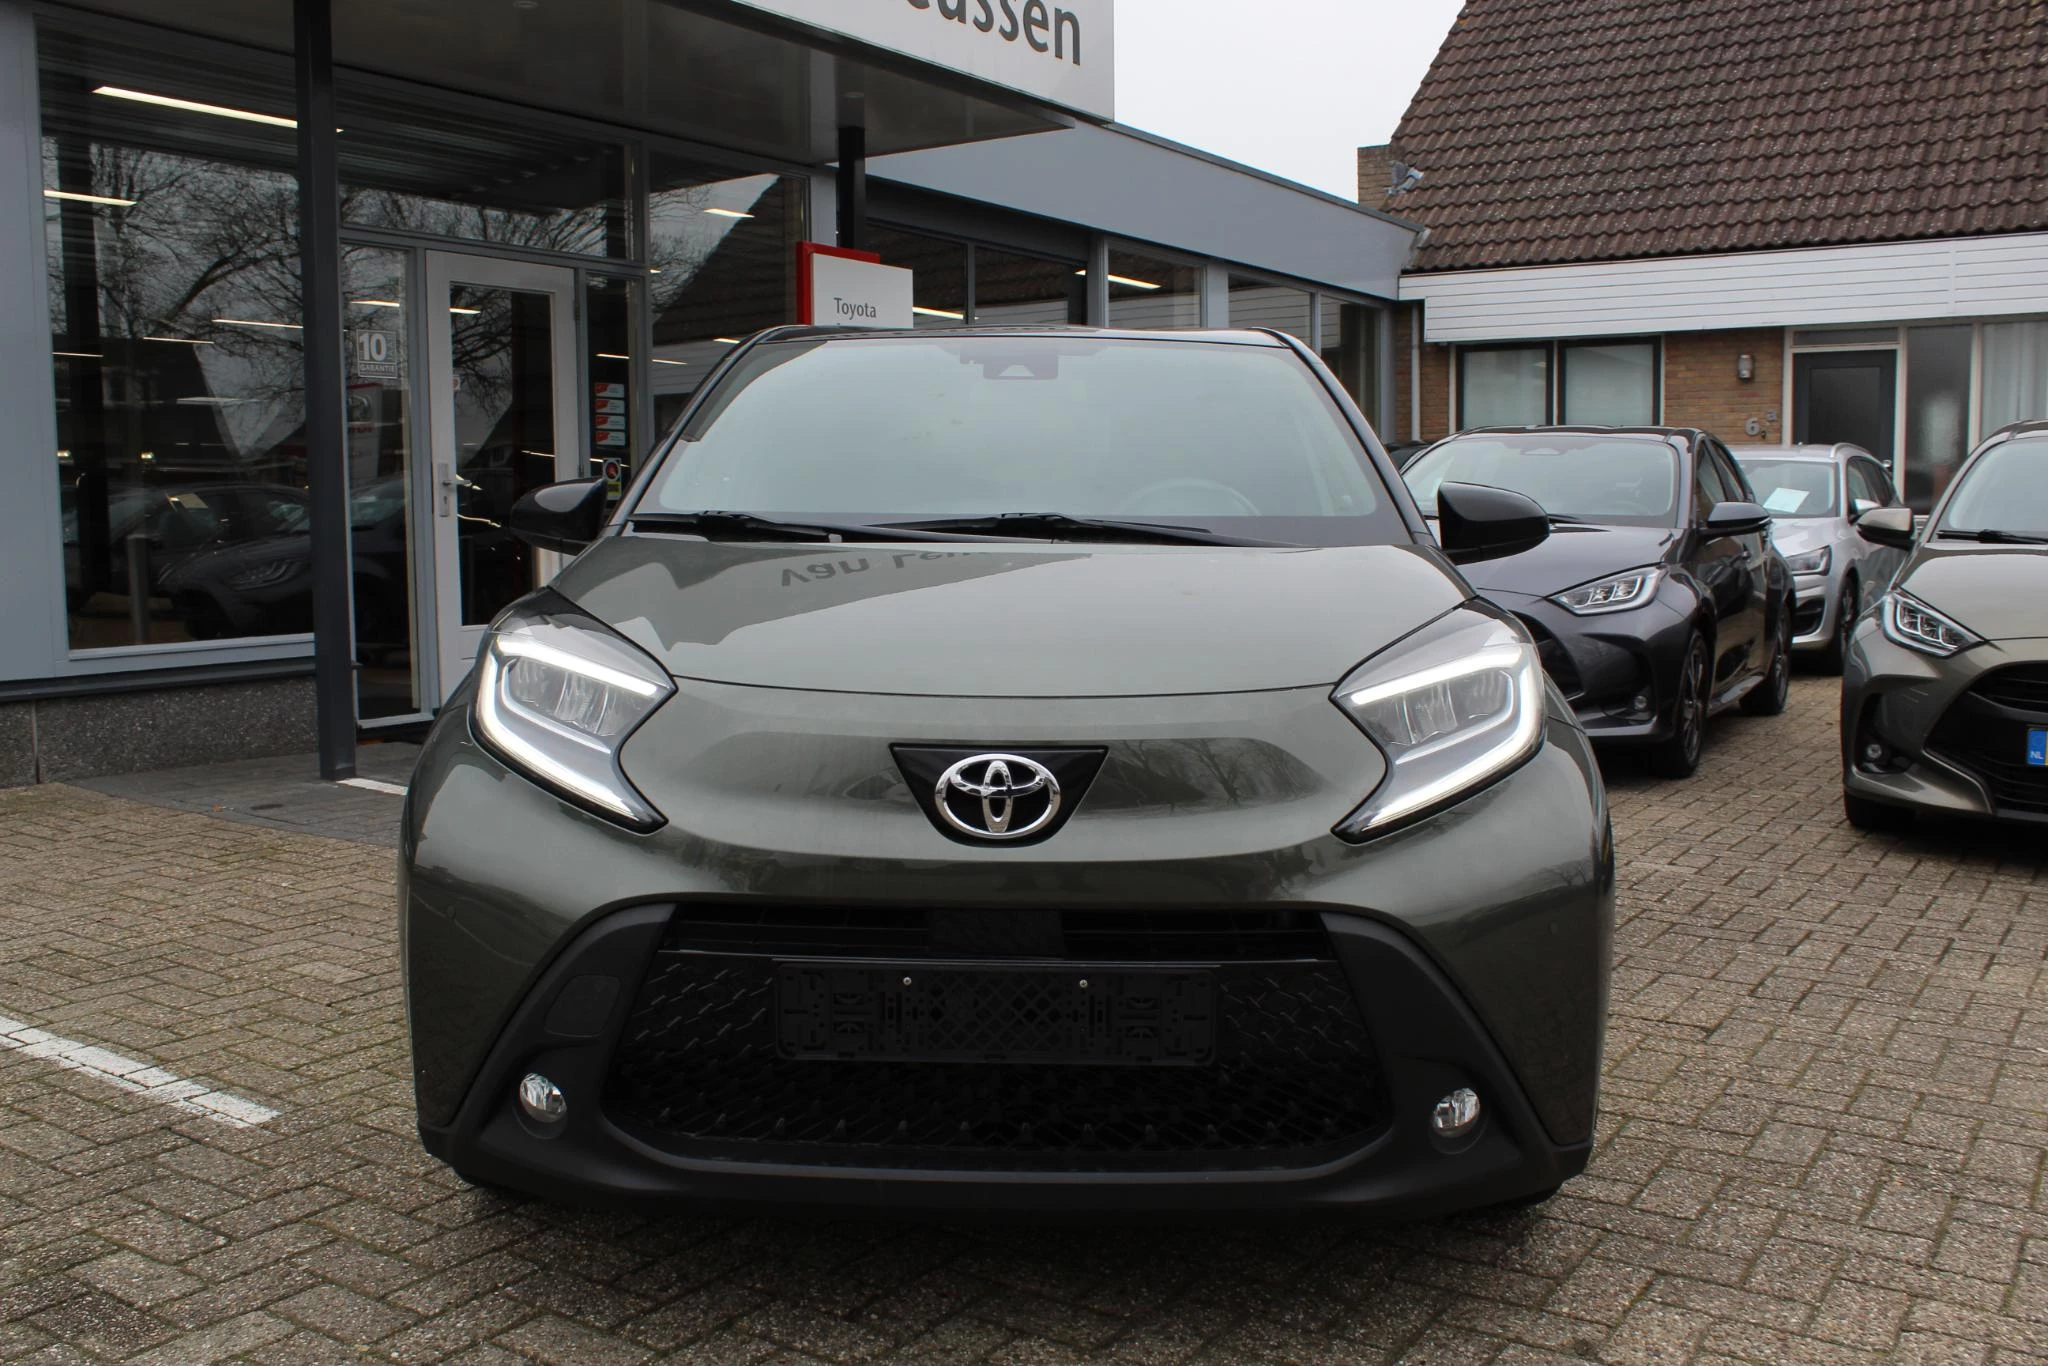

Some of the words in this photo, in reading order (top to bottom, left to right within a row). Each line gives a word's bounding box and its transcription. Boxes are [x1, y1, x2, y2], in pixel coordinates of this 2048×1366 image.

[907, 0, 1081, 66] ssen
[833, 297, 877, 320] Toyota
[359, 333, 387, 361] 10
[2029, 750, 2044, 760] NL
